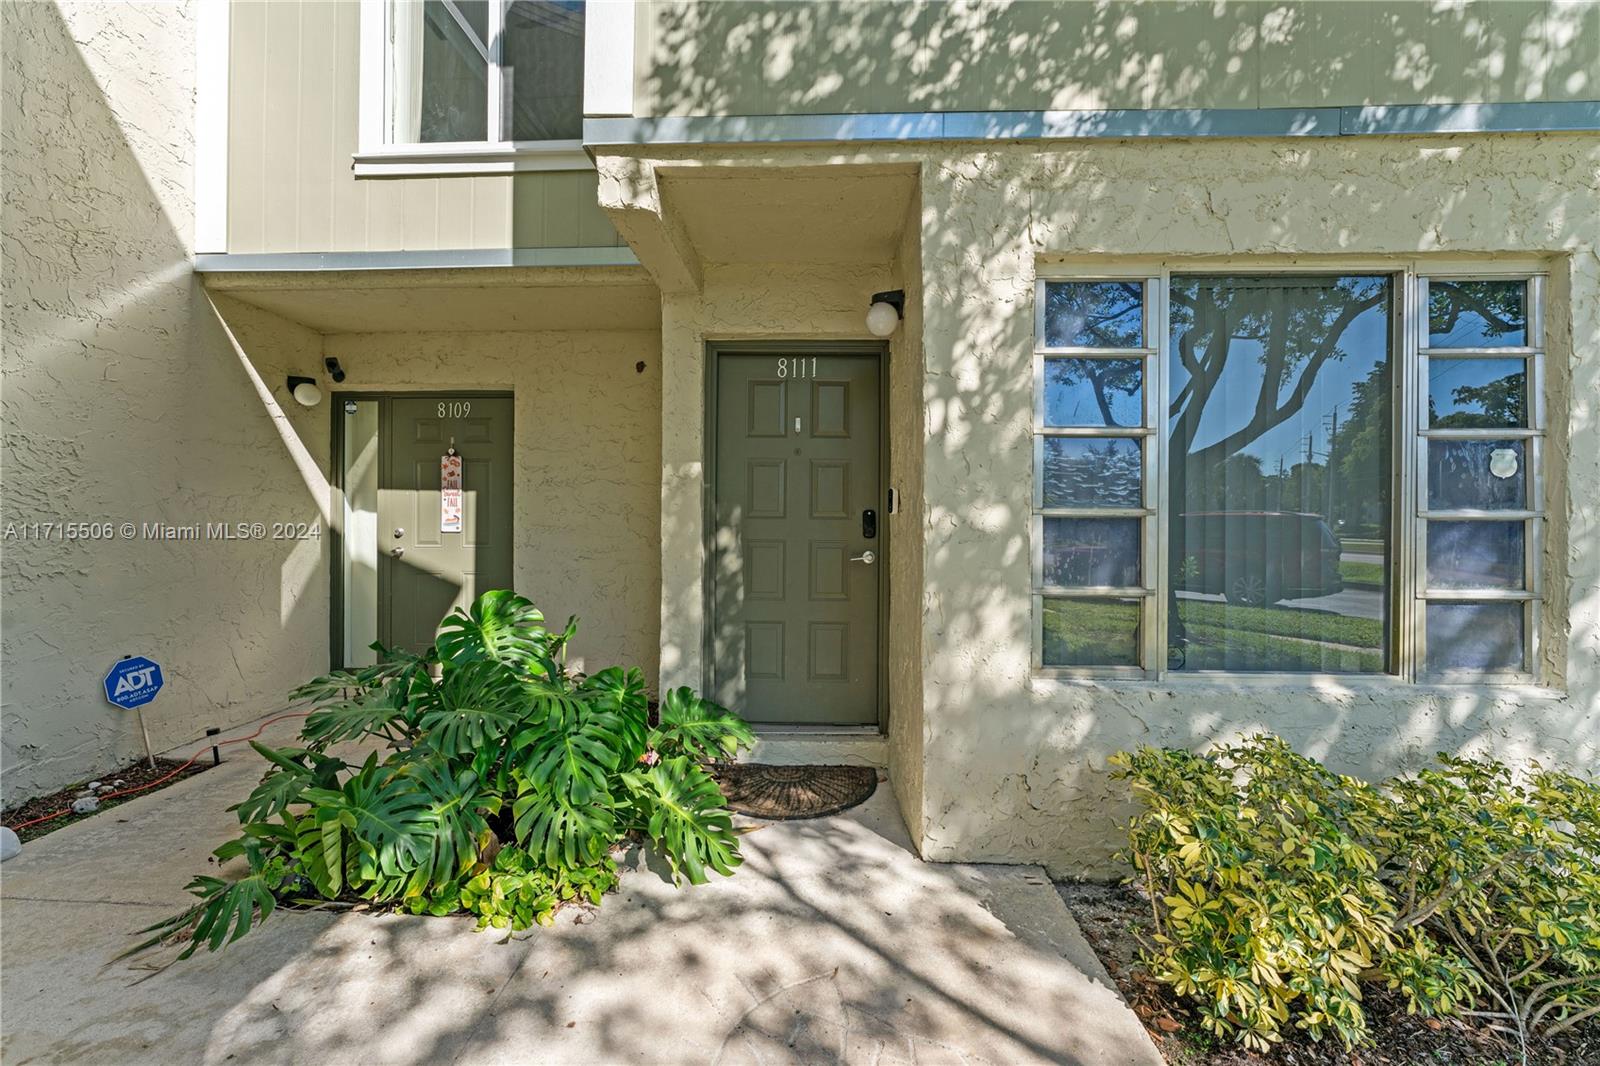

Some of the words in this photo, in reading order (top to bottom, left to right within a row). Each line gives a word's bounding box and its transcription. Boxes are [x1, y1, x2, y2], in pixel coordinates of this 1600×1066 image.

[777, 357, 817, 378] 8111
[438, 401, 471, 418] 8109
[114, 666, 156, 697] ADT
